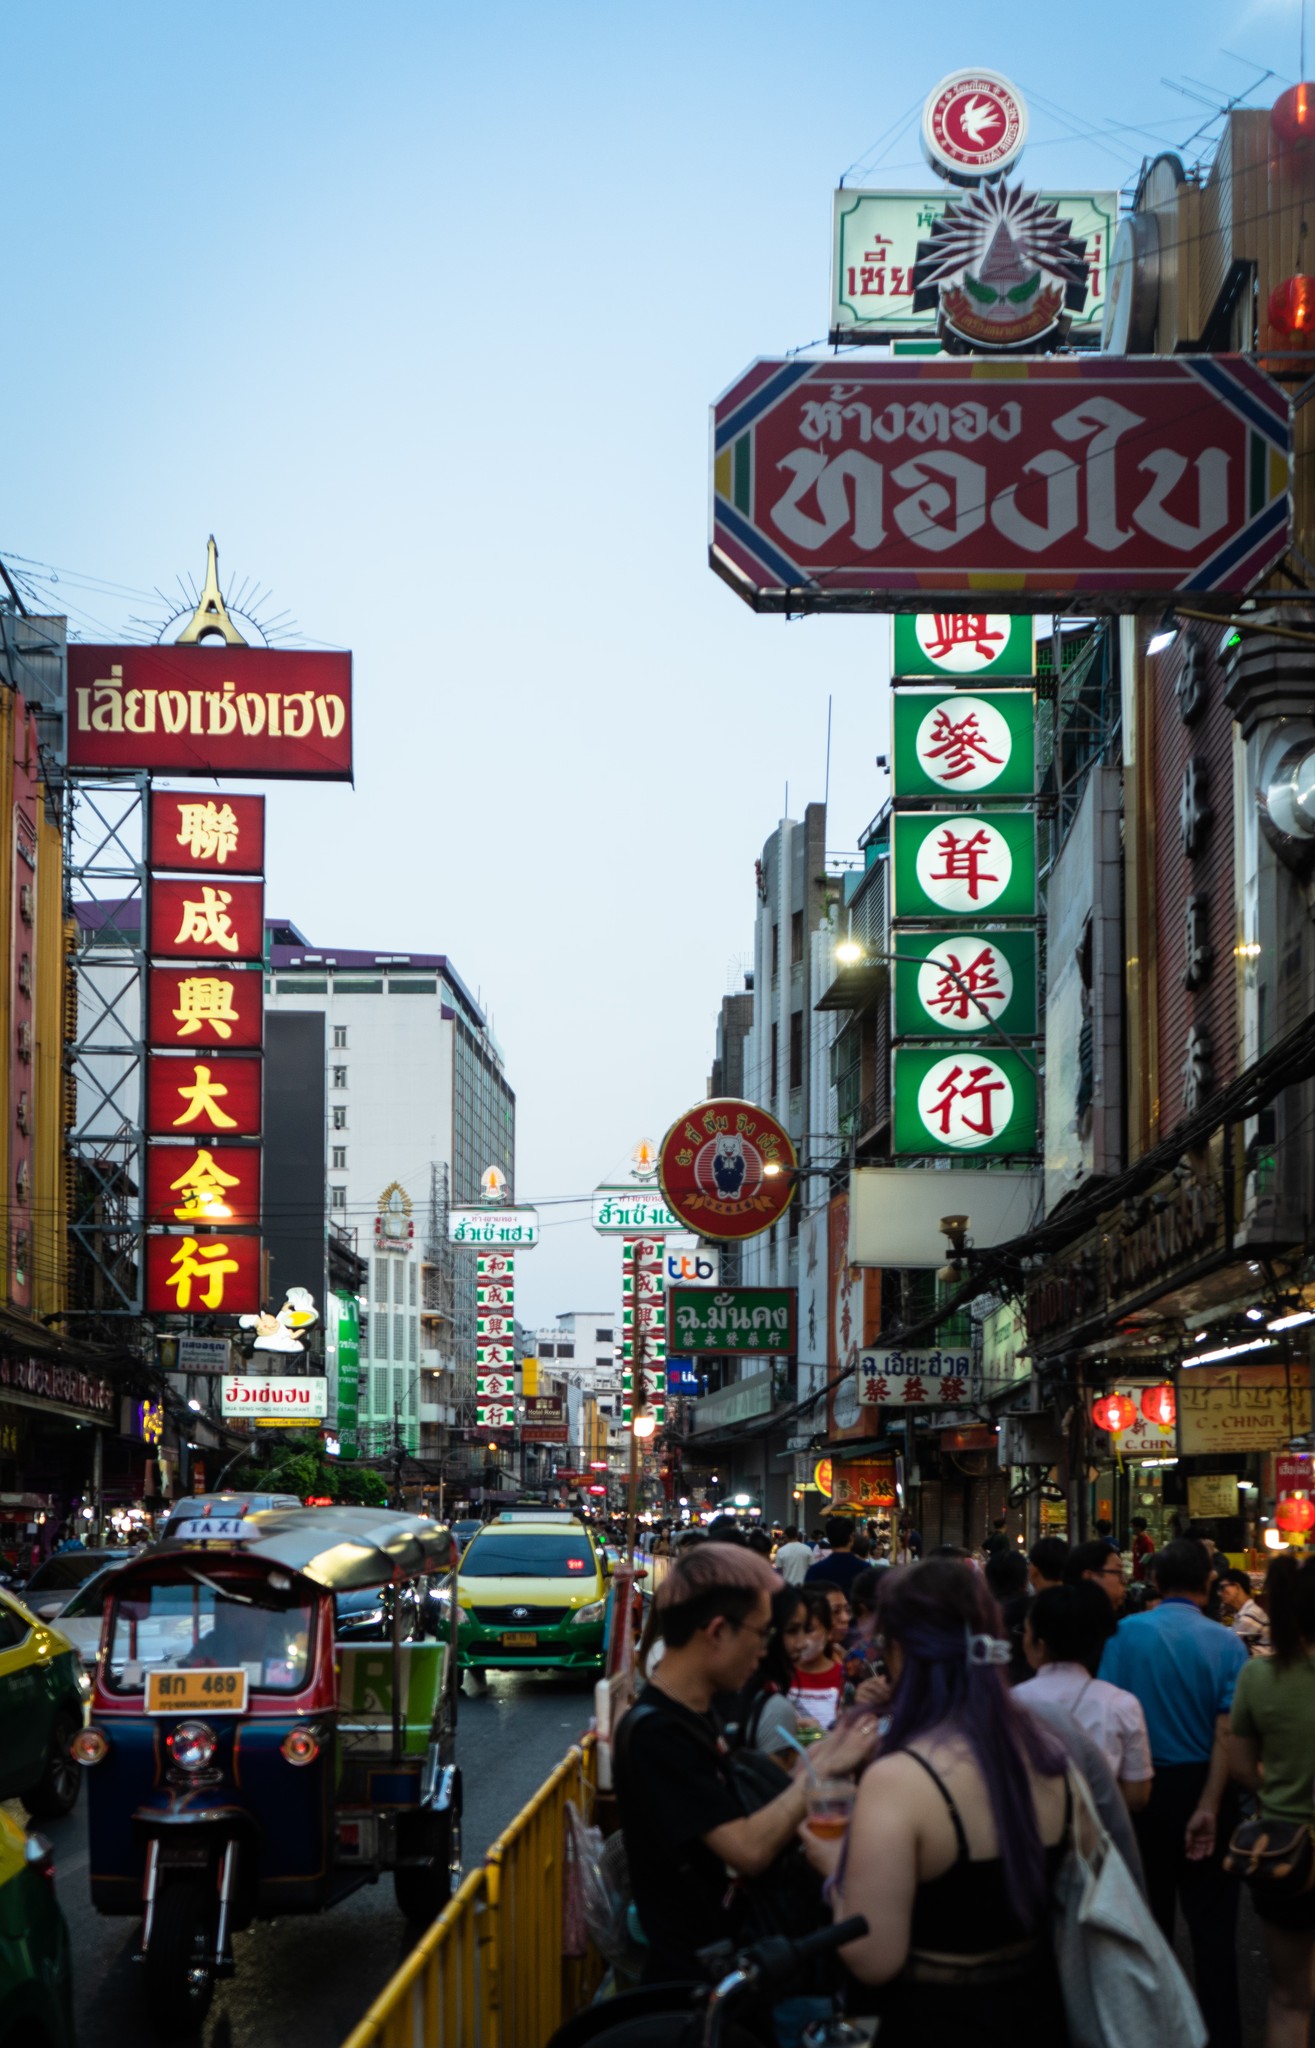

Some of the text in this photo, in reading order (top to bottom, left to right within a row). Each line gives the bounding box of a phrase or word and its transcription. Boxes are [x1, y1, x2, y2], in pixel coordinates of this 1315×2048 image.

[798, 384, 1023, 443] ห้างทอง
[770, 396, 1233, 553] ทองใบ
[166, 801, 240, 1310] 聯成興大金行
[668, 1256, 714, 1280] ttb
[676, 1292, 788, 1330] ฉ.มั่นคง
[487, 1257, 506, 1425] 和成興大金行
[863, 1376, 968, 1402] 蔡益發
[1221, 1414, 1275, 1429] CHINA
[1124, 1439, 1176, 1449] C. CHIN
[189, 1520, 242, 1534] TAXI
